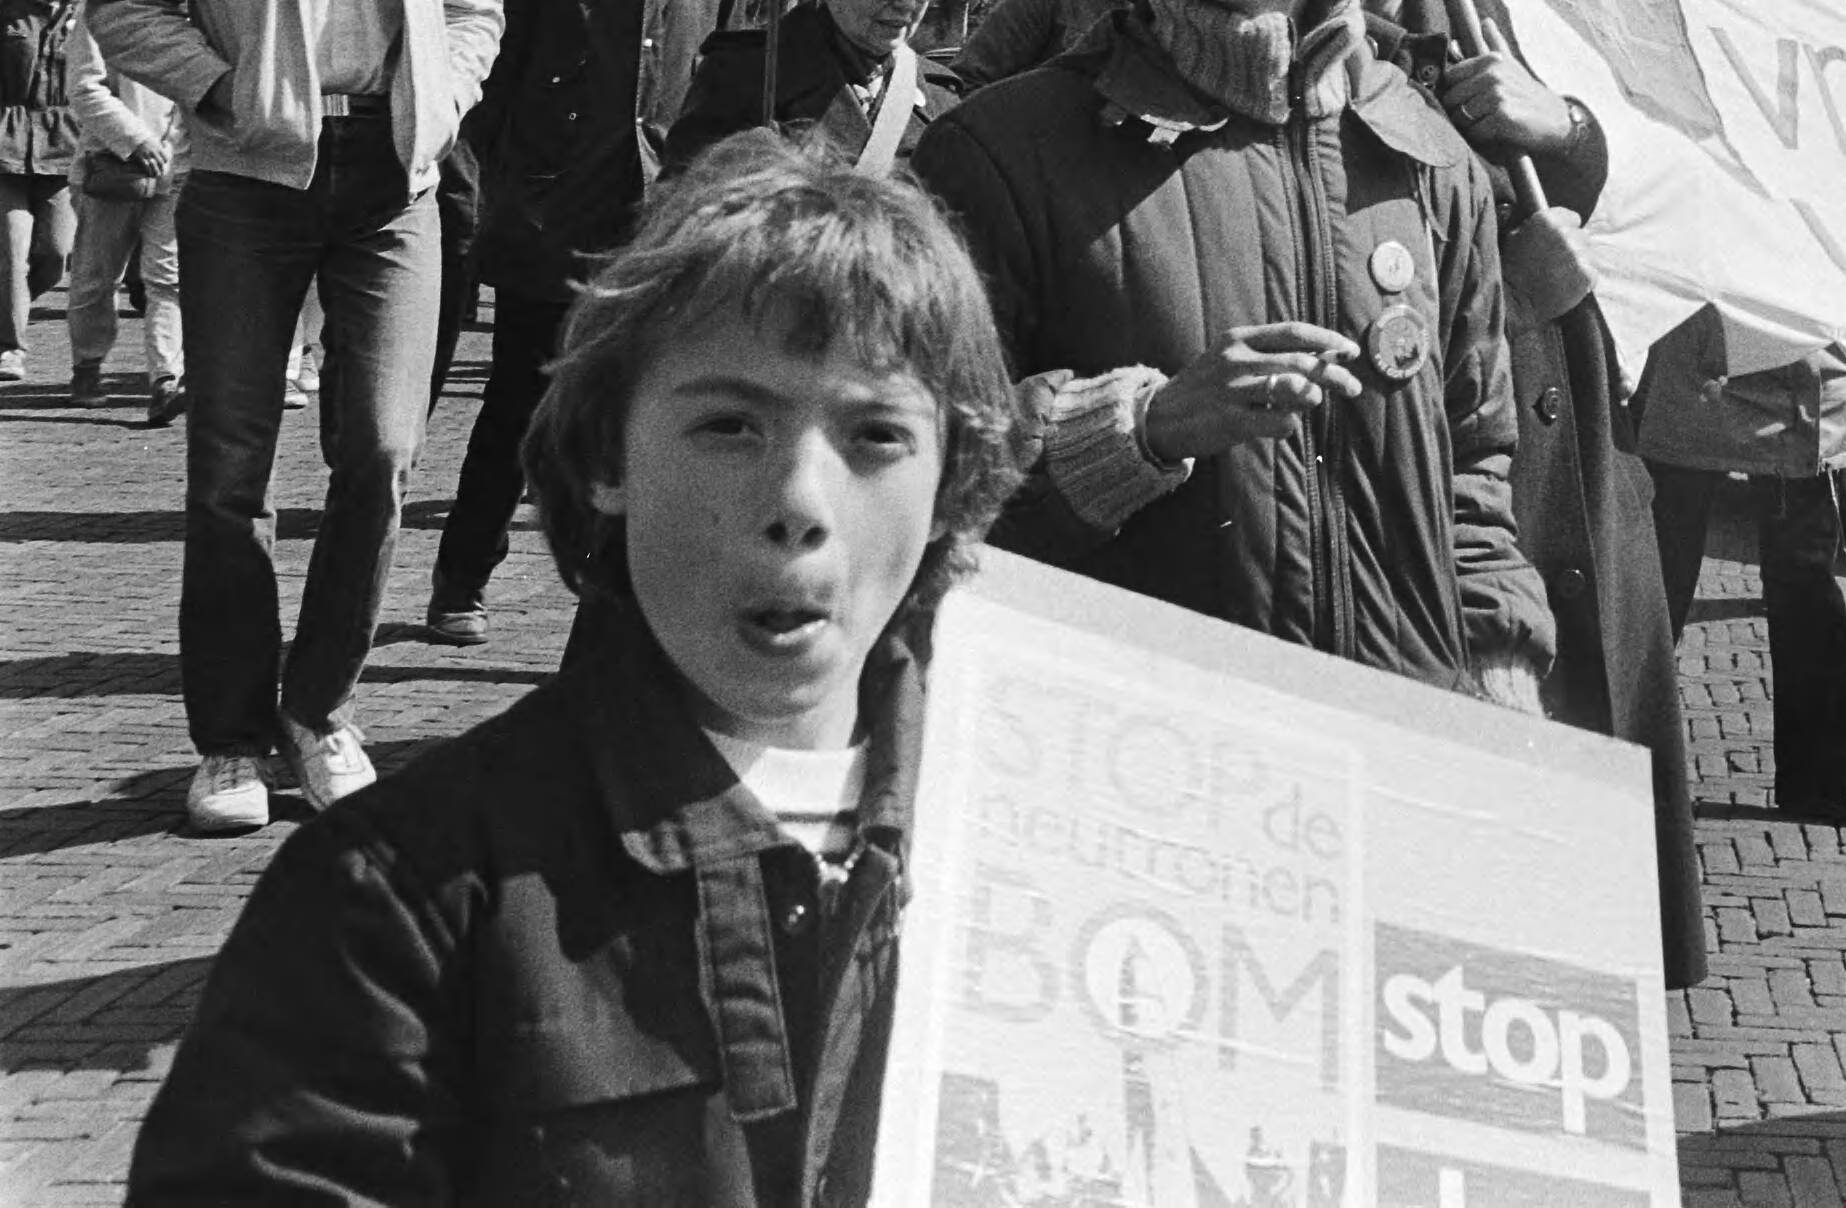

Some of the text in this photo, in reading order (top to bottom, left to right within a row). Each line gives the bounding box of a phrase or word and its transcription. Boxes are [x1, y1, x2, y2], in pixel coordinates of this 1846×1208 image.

[976, 676, 1272, 830] STOP
[1262, 783, 1344, 860] de
[976, 793, 1342, 925] neutronen
[953, 861, 1341, 1094] BOM
[1383, 965, 1631, 1134] stop
